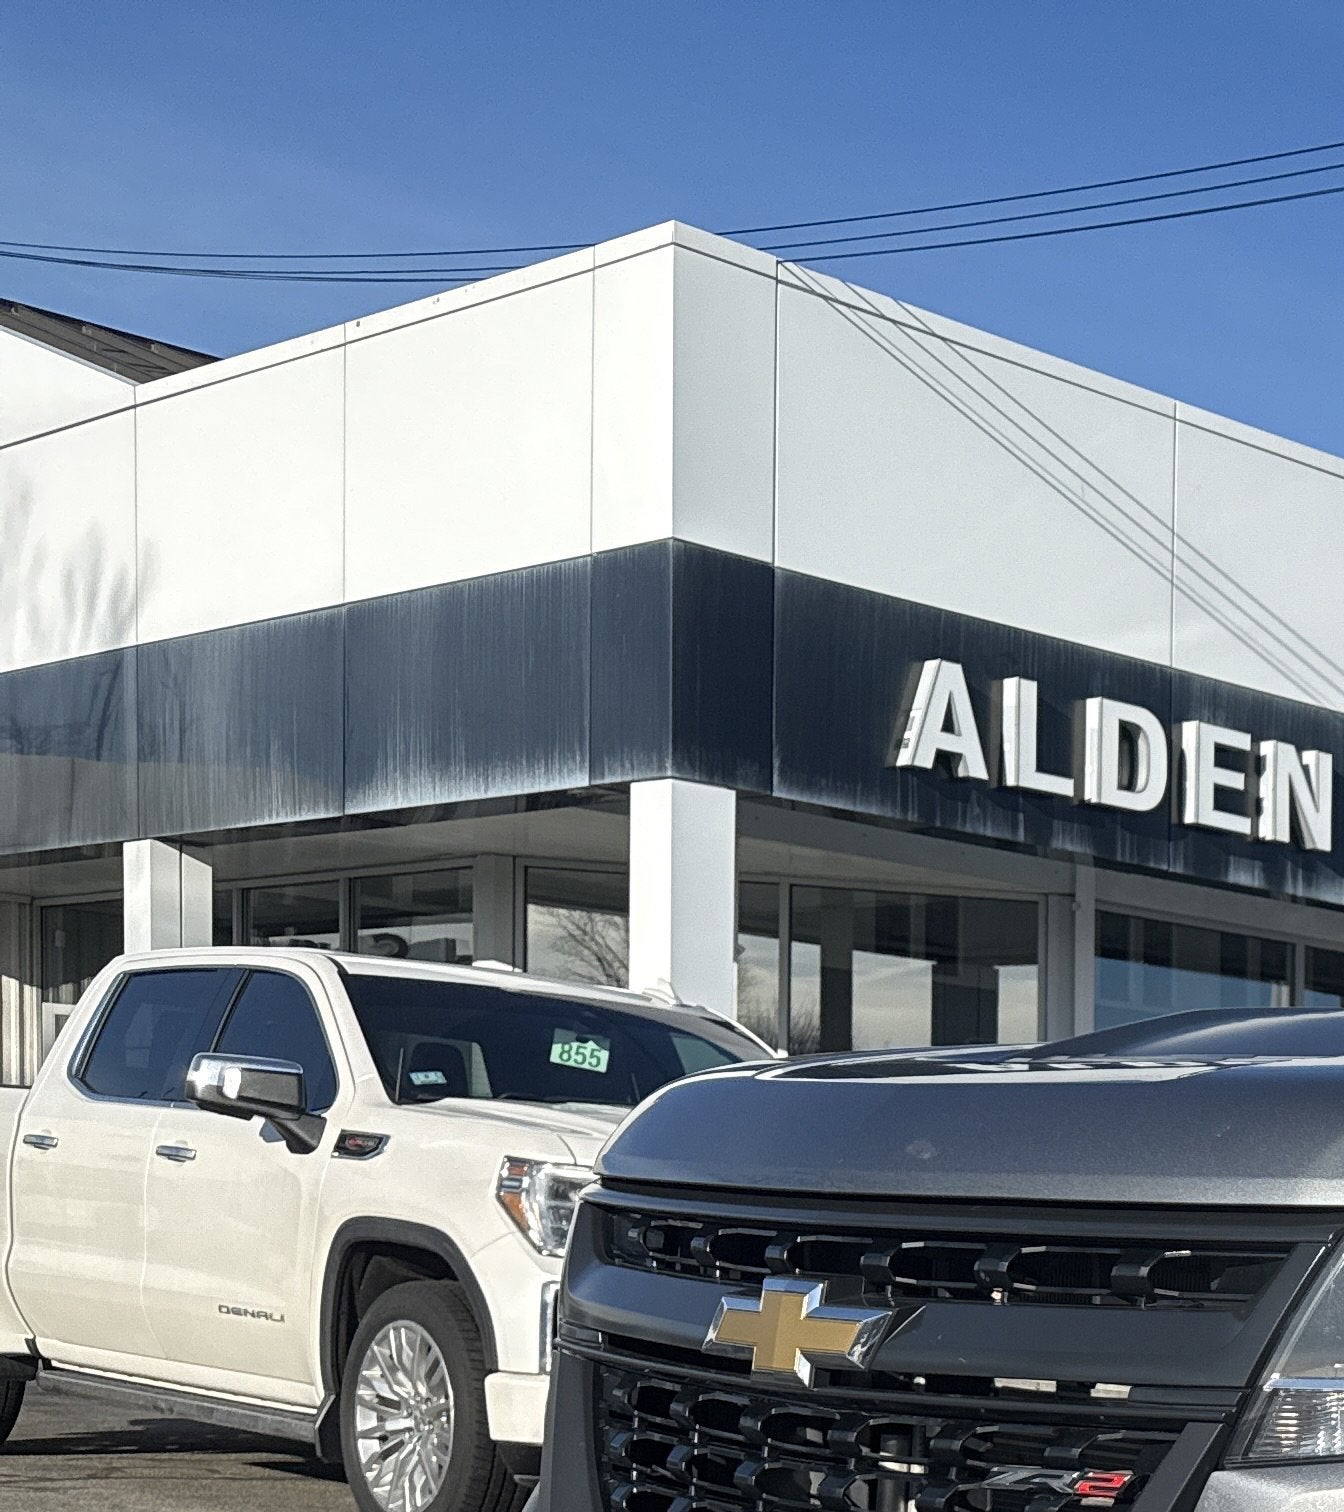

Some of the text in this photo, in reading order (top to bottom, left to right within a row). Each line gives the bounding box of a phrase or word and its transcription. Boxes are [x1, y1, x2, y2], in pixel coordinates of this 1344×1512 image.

[896, 657, 1333, 853] ALDEN
[558, 1042, 601, 1068] 855
[218, 1303, 285, 1323] DENALI
[981, 1466, 1136, 1499] ZR2
